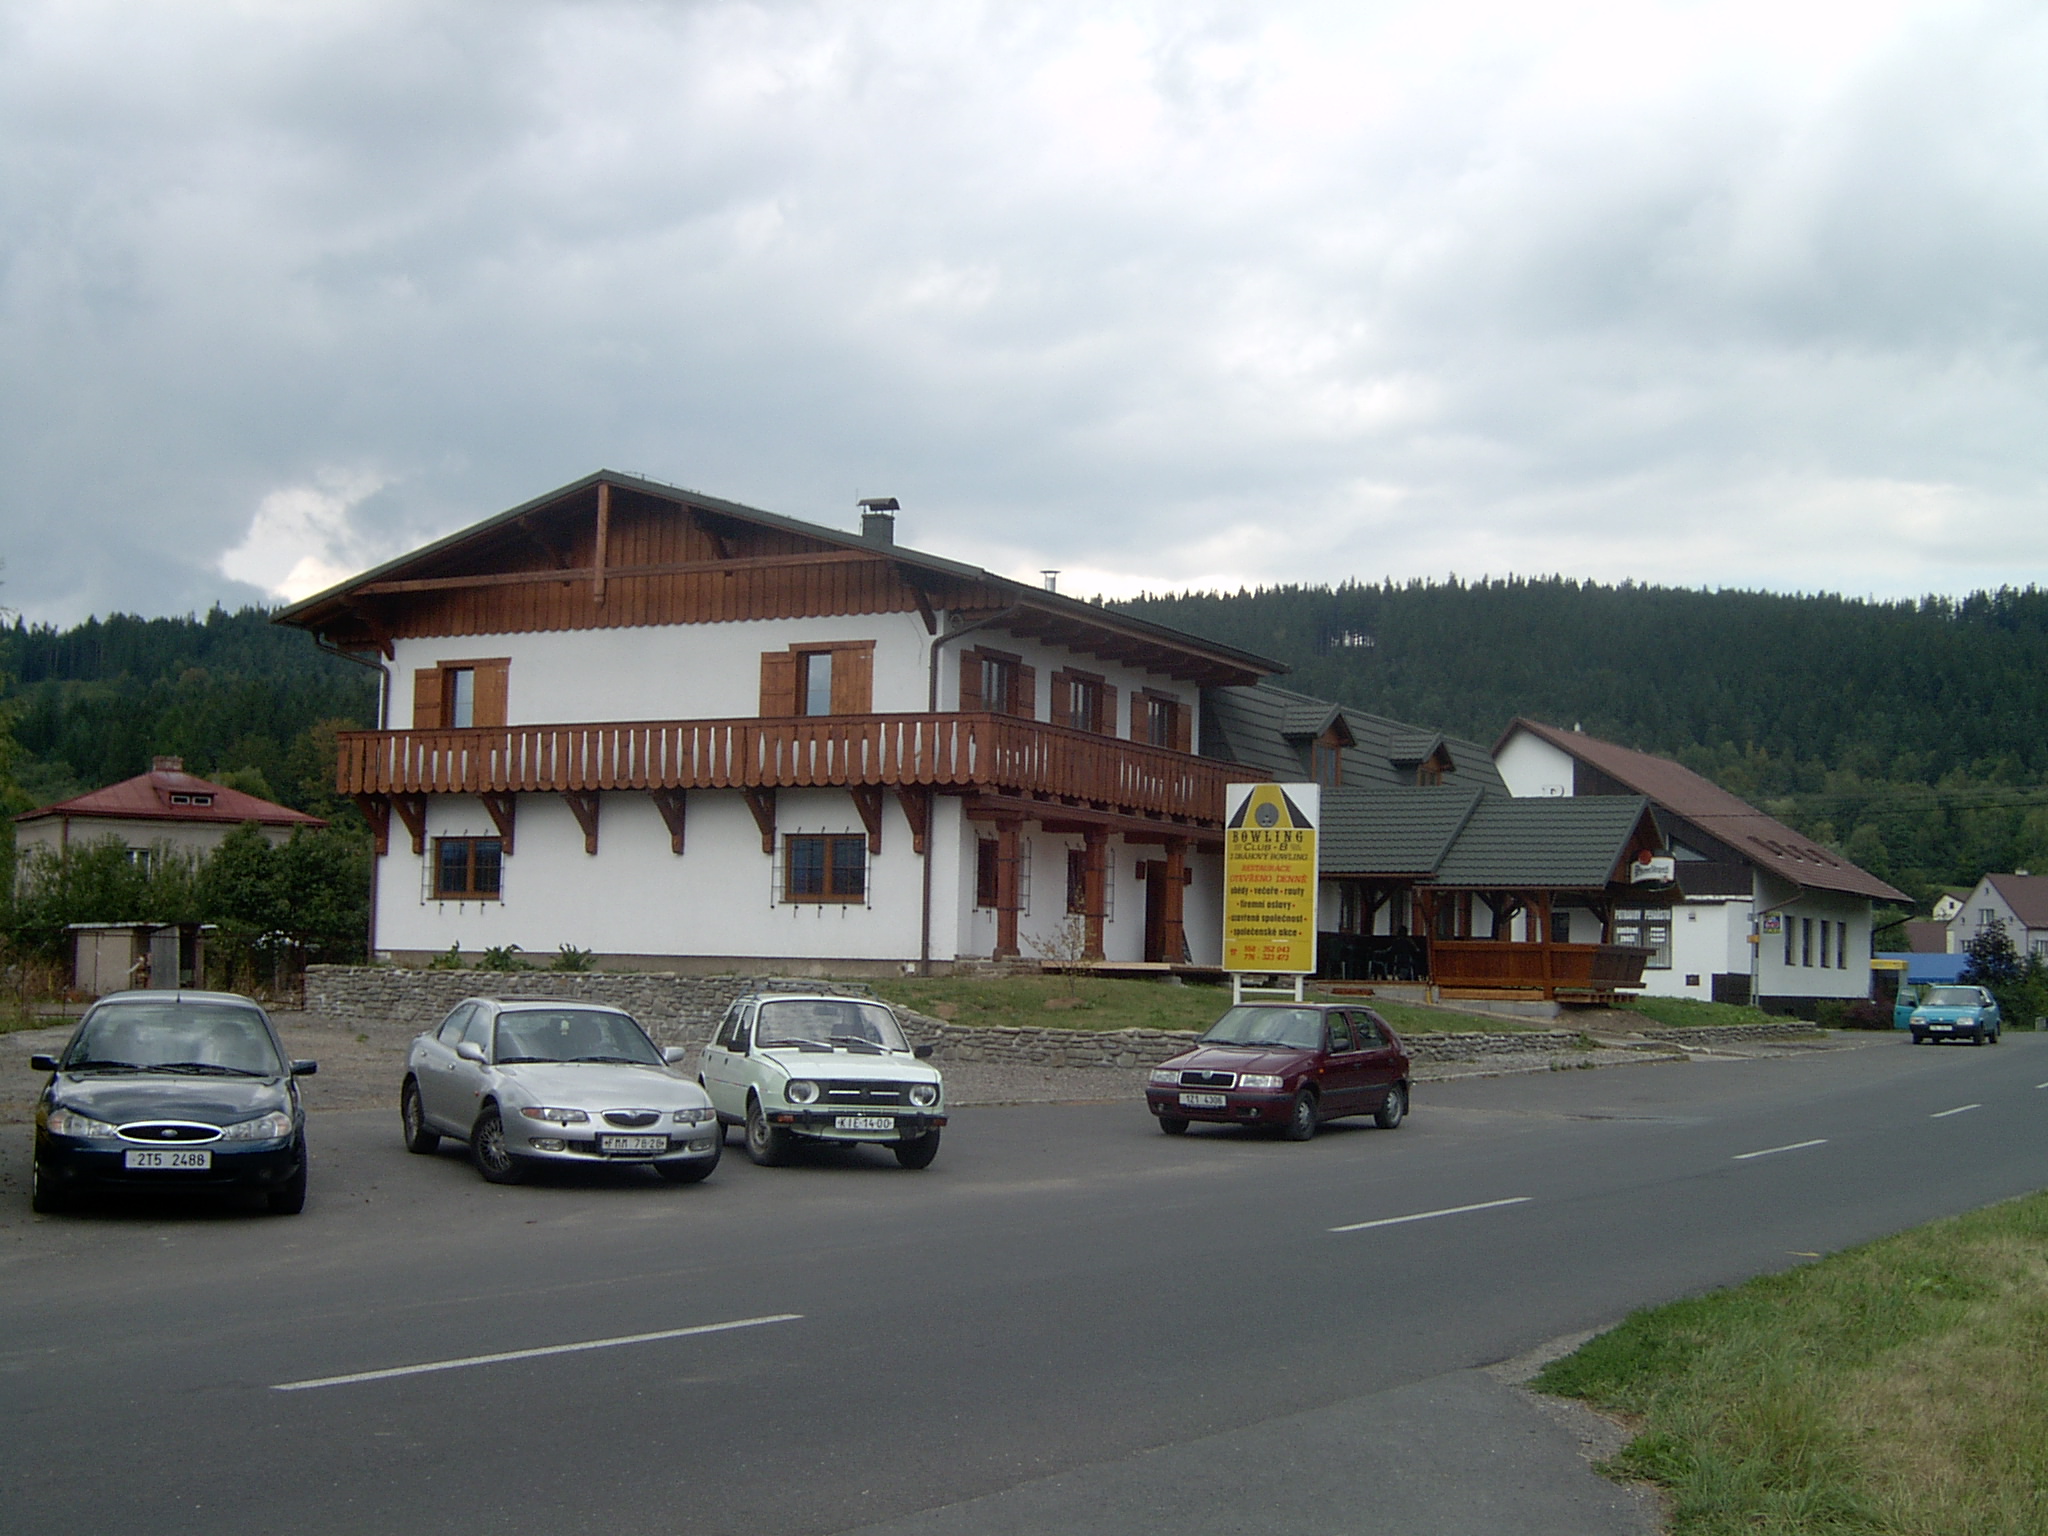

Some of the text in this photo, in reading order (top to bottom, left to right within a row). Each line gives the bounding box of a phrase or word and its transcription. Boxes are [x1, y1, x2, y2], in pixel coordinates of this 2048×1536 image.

[1232, 830, 1303, 843] BOWLING
[1243, 842, 1271, 851] CLUB
[1270, 852, 1309, 861] BOWLING
[137, 1152, 205, 1167] 2T5 2488
